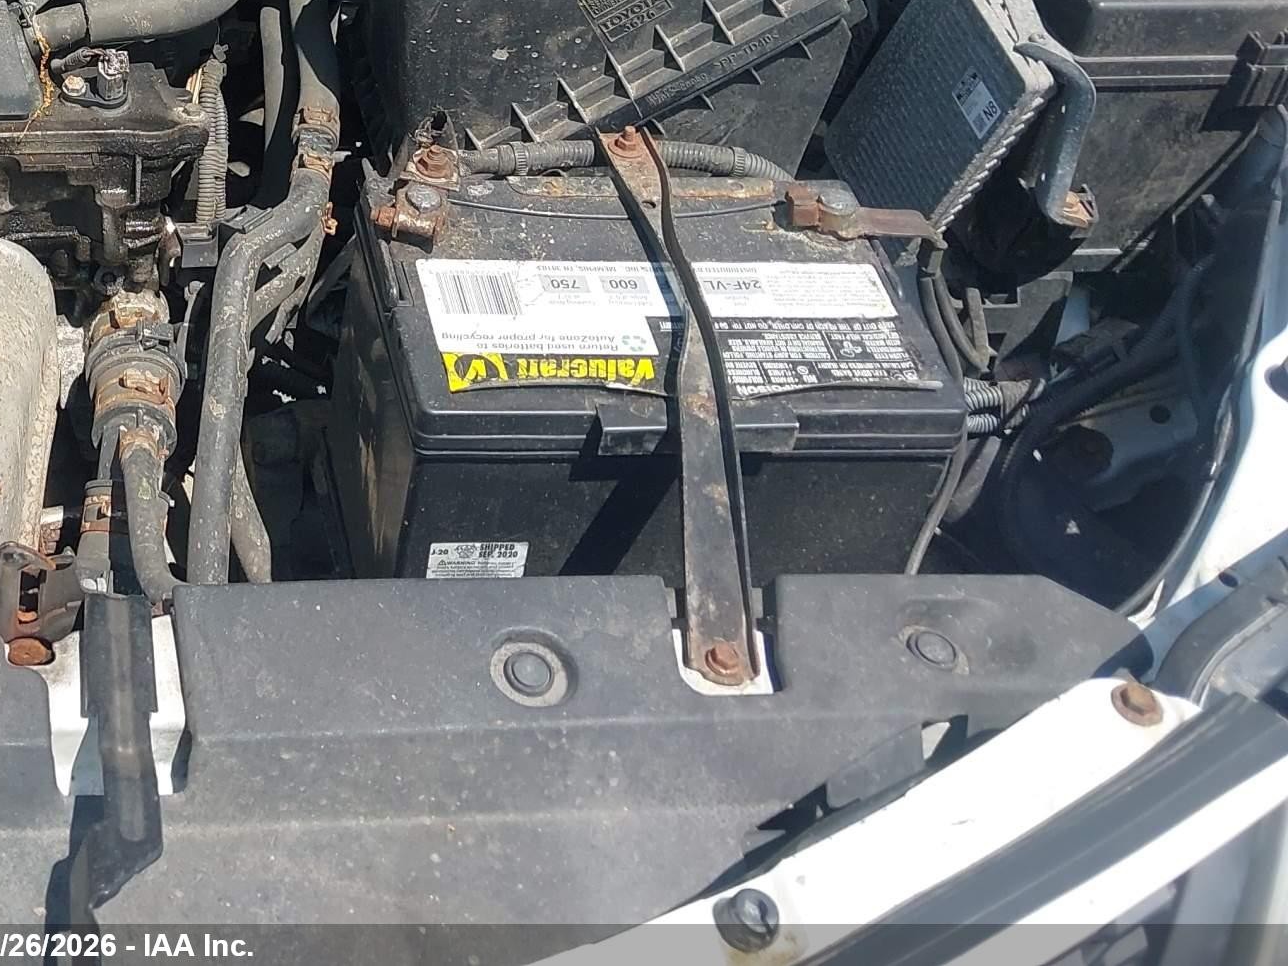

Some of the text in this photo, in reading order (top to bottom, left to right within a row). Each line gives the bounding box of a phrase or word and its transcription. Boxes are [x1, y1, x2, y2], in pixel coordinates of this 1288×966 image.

[982, 100, 998, 121] N8
[550, 279, 579, 289] 750
[609, 279, 637, 290] 600
[703, 280, 762, 290] 24F-VL
[441, 332, 494, 341] recycling
[497, 332, 536, 341] proper
[559, 334, 615, 343] AutoZone
[491, 342, 543, 351] batteries
[579, 343, 618, 352] Return
[479, 543, 515, 551] SHIPPED
[496, 550, 518, 558] 2020
